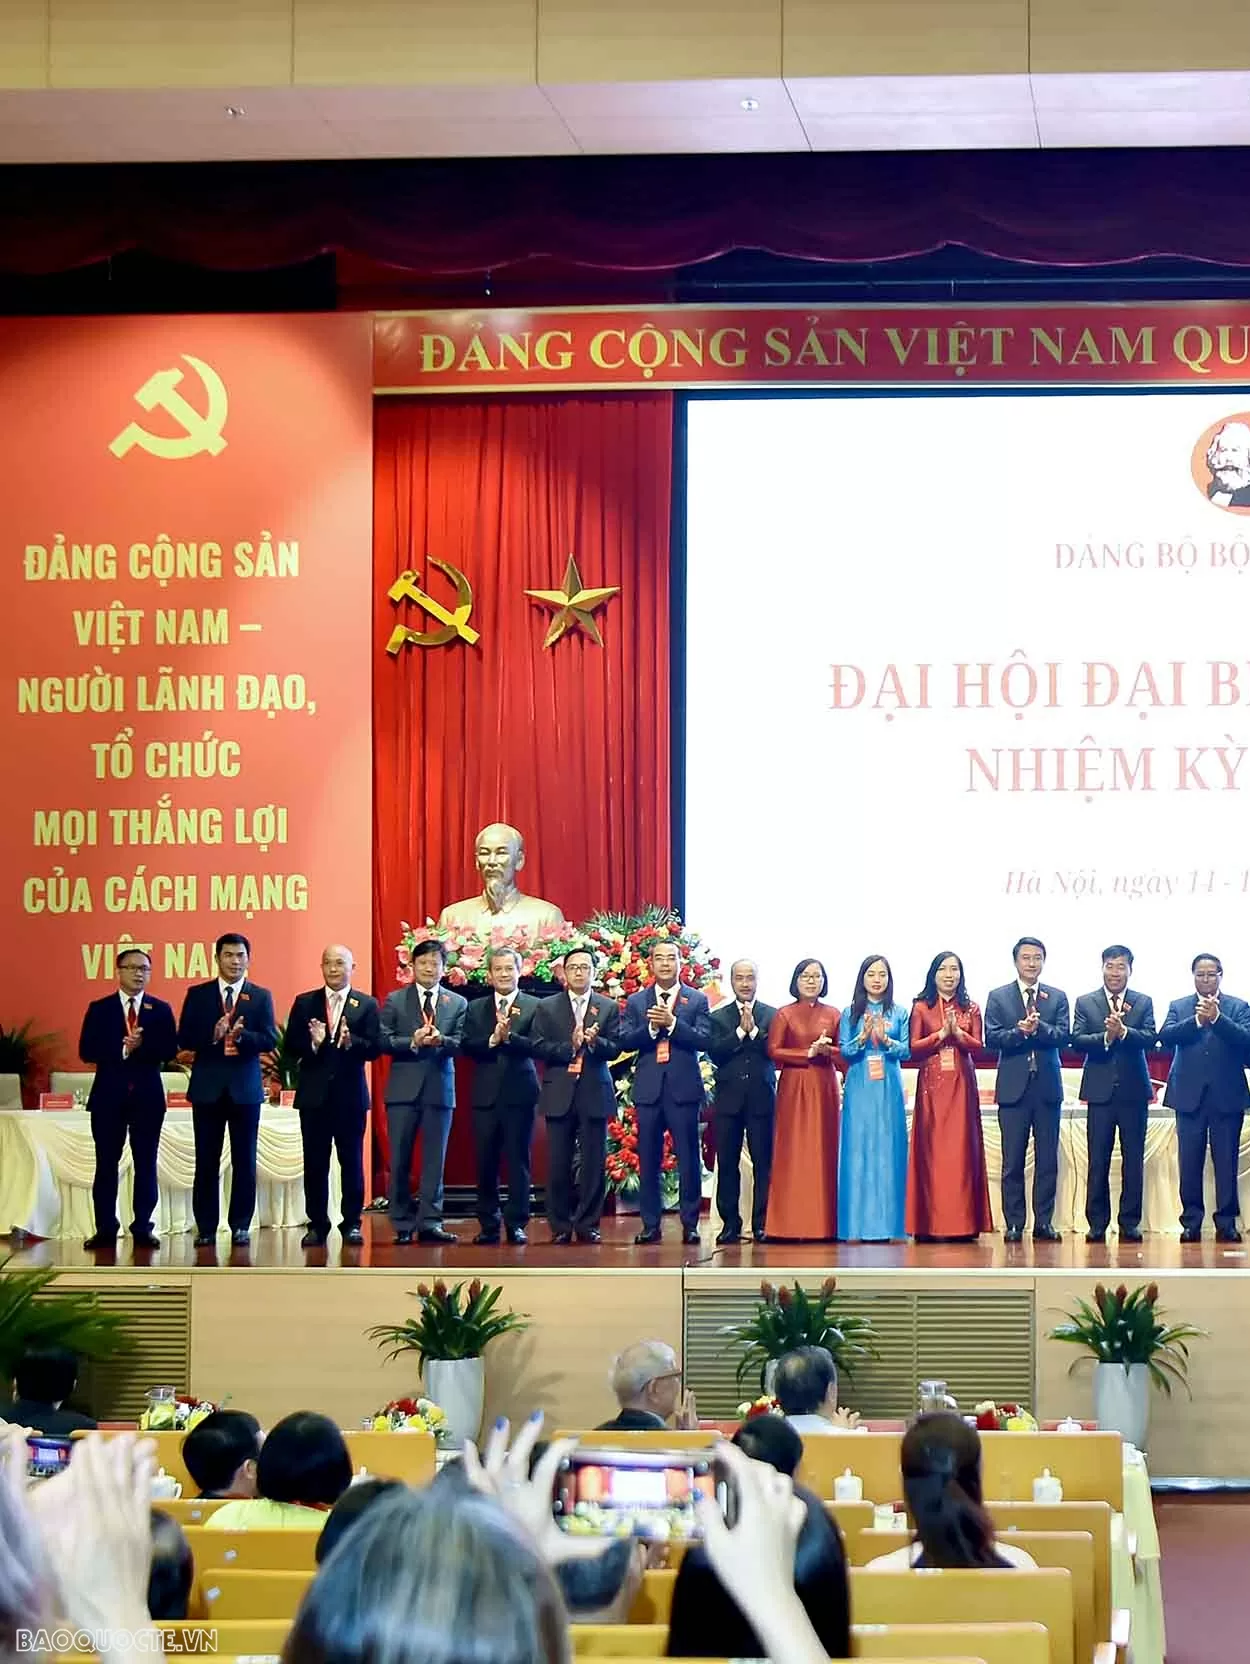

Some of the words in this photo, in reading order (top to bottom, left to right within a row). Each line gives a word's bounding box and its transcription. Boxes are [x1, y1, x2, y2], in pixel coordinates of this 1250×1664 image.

[419, 321, 574, 374] ĐẢNG
[590, 322, 748, 379] CỘNG
[764, 315, 870, 367] SẢN
[883, 321, 1014, 377] VIỆT
[1030, 324, 1155, 366] NAM
[23, 532, 117, 580] ĐẢNG
[128, 533, 223, 587] CỘNG
[233, 530, 300, 578] SẢN
[73, 600, 145, 654] VIỆT
[155, 608, 229, 645] NAM
[17, 665, 125, 713] NGƯỜI
[136, 666, 225, 712] LÃNH
[236, 674, 317, 719] ĐẠO,
[828, 661, 934, 721] ĐẠI
[951, 647, 1061, 721] HỘI
[1080, 659, 1189, 720] ĐẠI
[91, 727, 134, 779] TỔ
[145, 729, 241, 778] CHỨC
[964, 733, 1155, 803] NHIỆM
[1174, 733, 1250, 793] KỲ
[34, 810, 97, 854] MỌI
[109, 793, 223, 845] THẮNG
[235, 804, 289, 852] LỢI
[23, 866, 93, 913] CỦA
[104, 865, 197, 912] CÁCH
[210, 874, 309, 919] MẠNG
